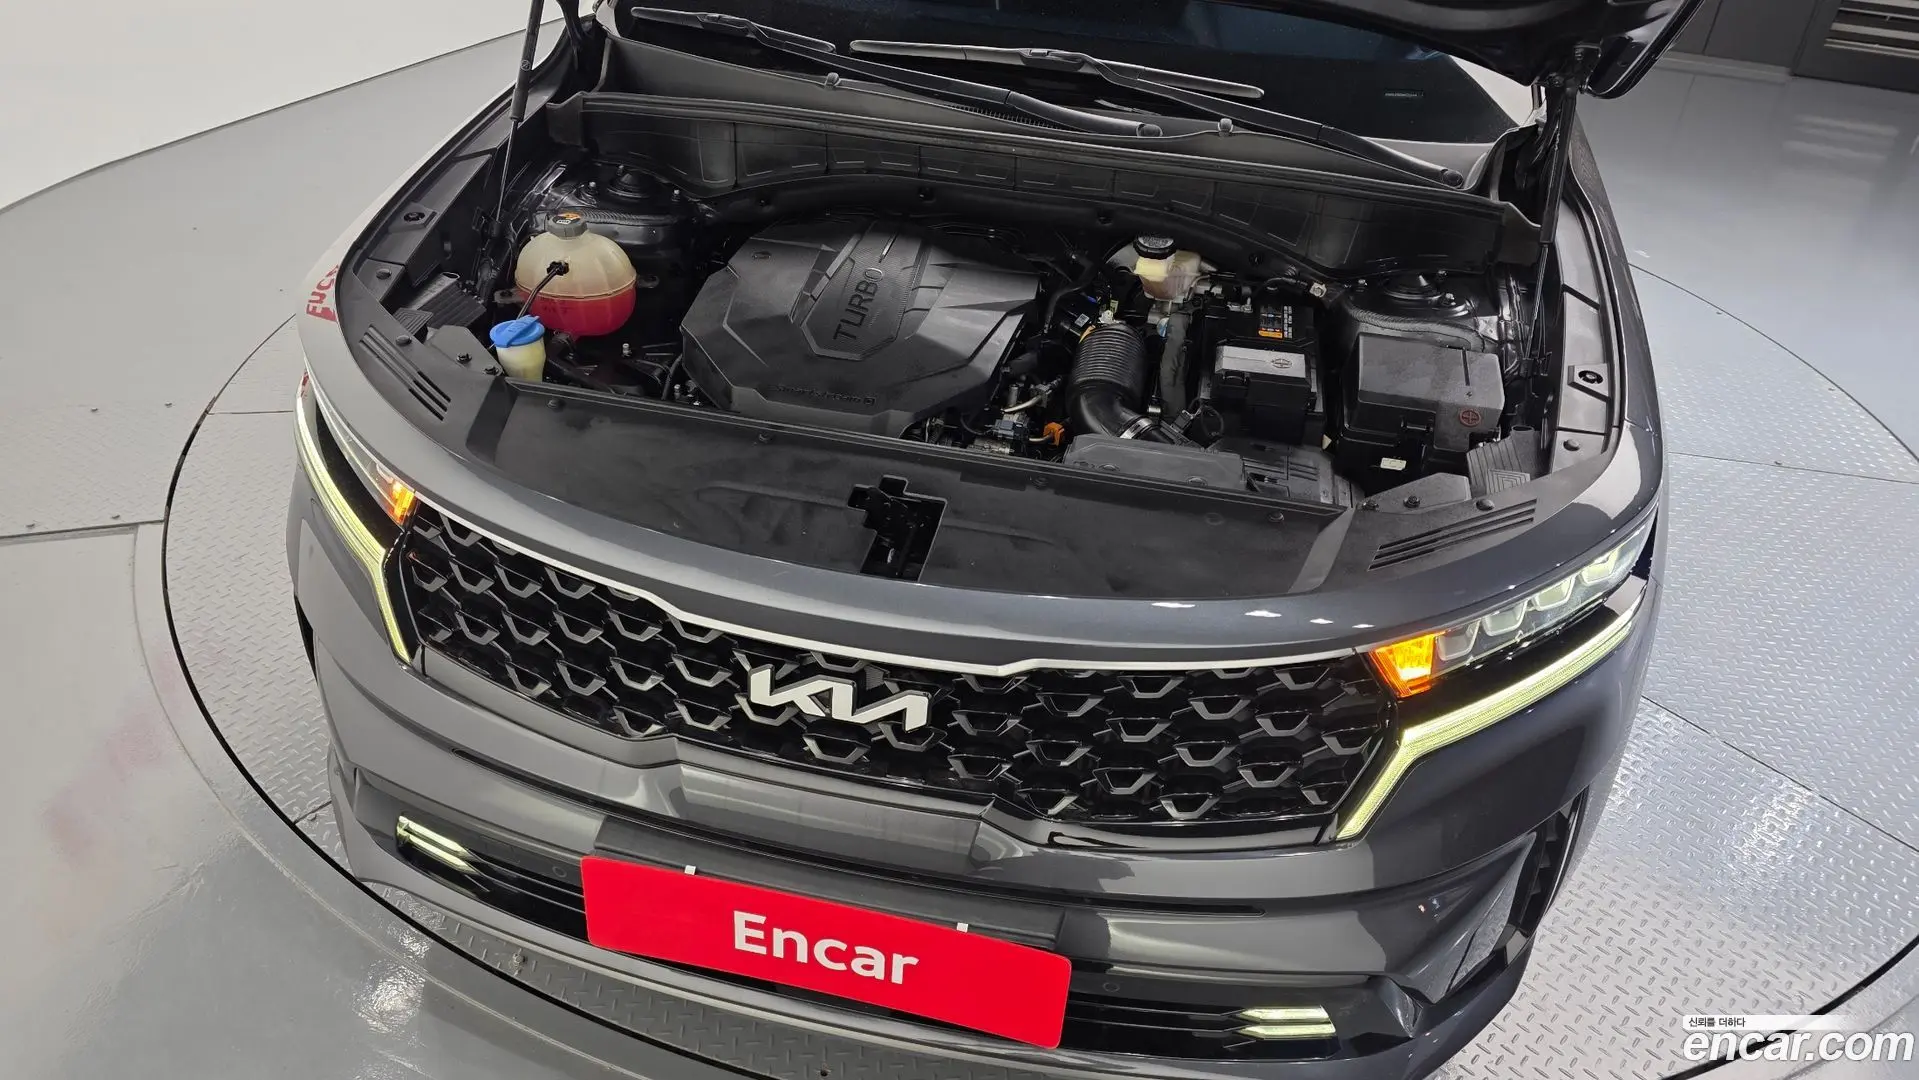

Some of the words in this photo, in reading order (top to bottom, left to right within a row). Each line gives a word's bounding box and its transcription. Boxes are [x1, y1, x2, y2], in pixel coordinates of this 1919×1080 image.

[833, 267, 883, 340] TURBO
[749, 664, 930, 732] KIA
[733, 910, 919, 985] Encar
